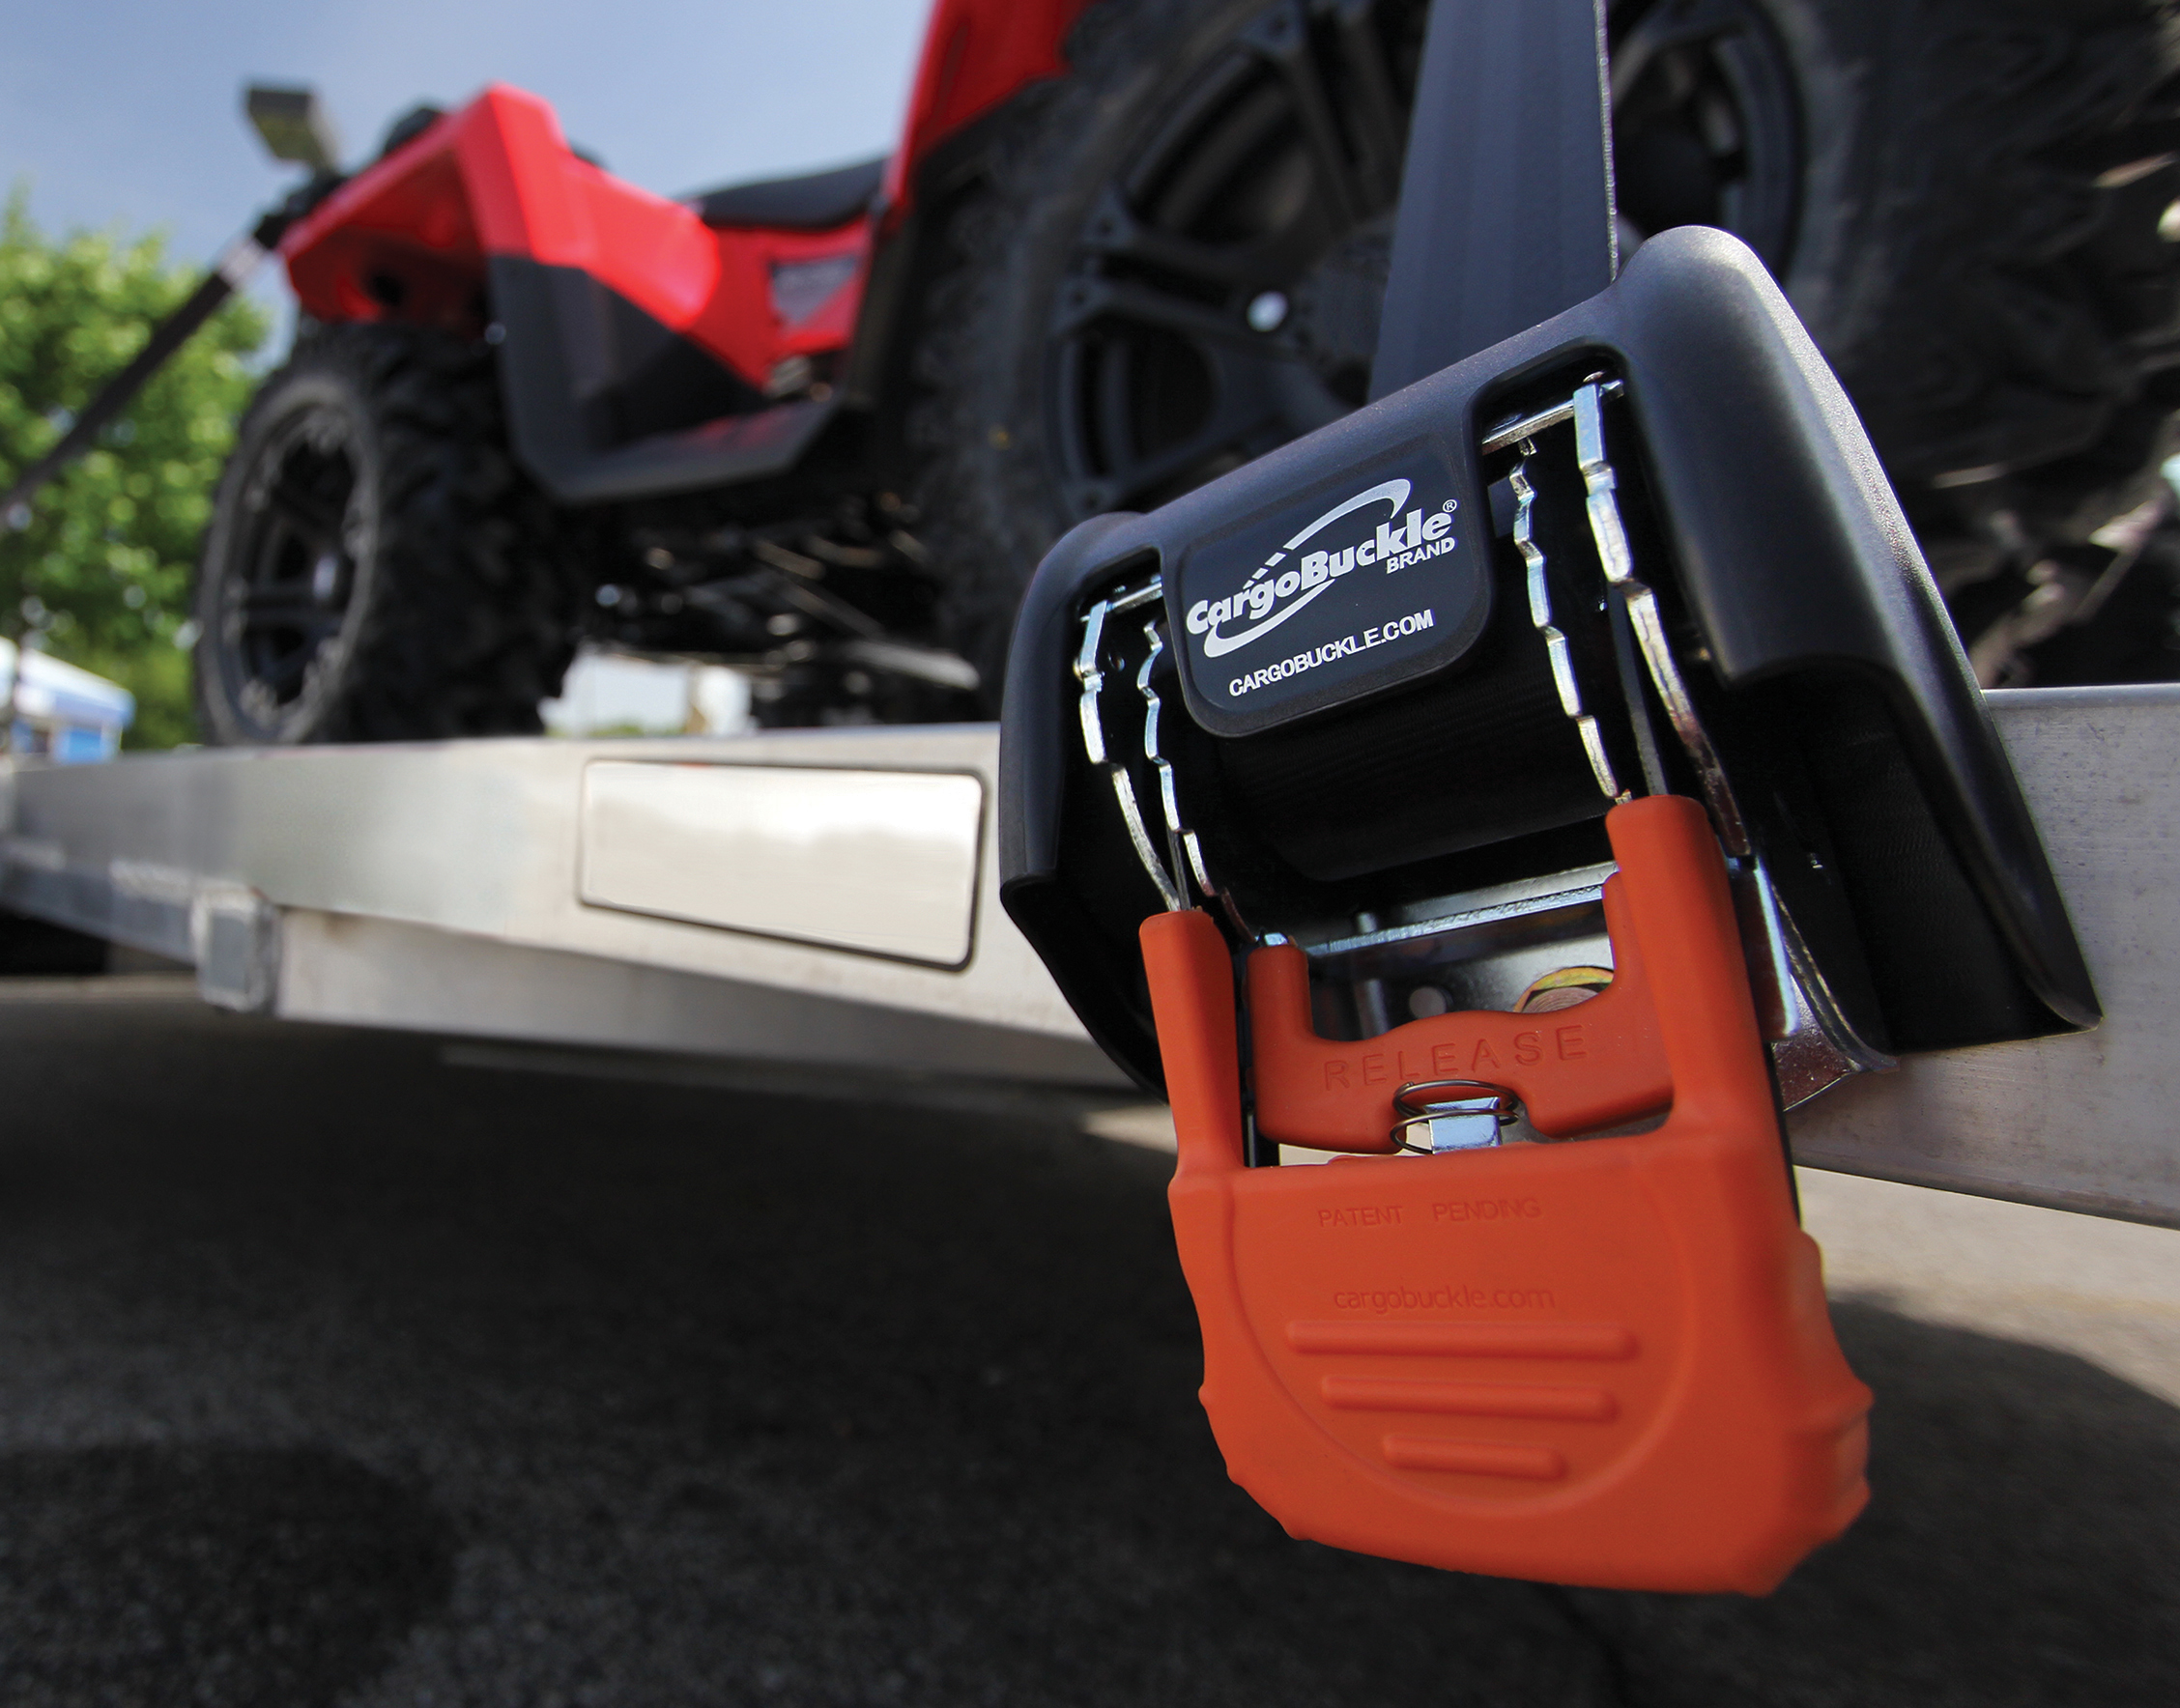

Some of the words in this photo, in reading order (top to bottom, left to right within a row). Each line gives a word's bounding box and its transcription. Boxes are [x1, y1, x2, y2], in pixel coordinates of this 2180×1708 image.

[1386, 536, 1456, 574] BRAND
[1228, 609, 1435, 697] CARGOBUCKLE.COM
[1323, 1025, 1588, 1091] RELEASE
[1317, 1205, 1404, 1228] PATENT
[1431, 1198, 1542, 1222] PENDING
[1333, 1284, 1556, 1316] cargobuckle.com
